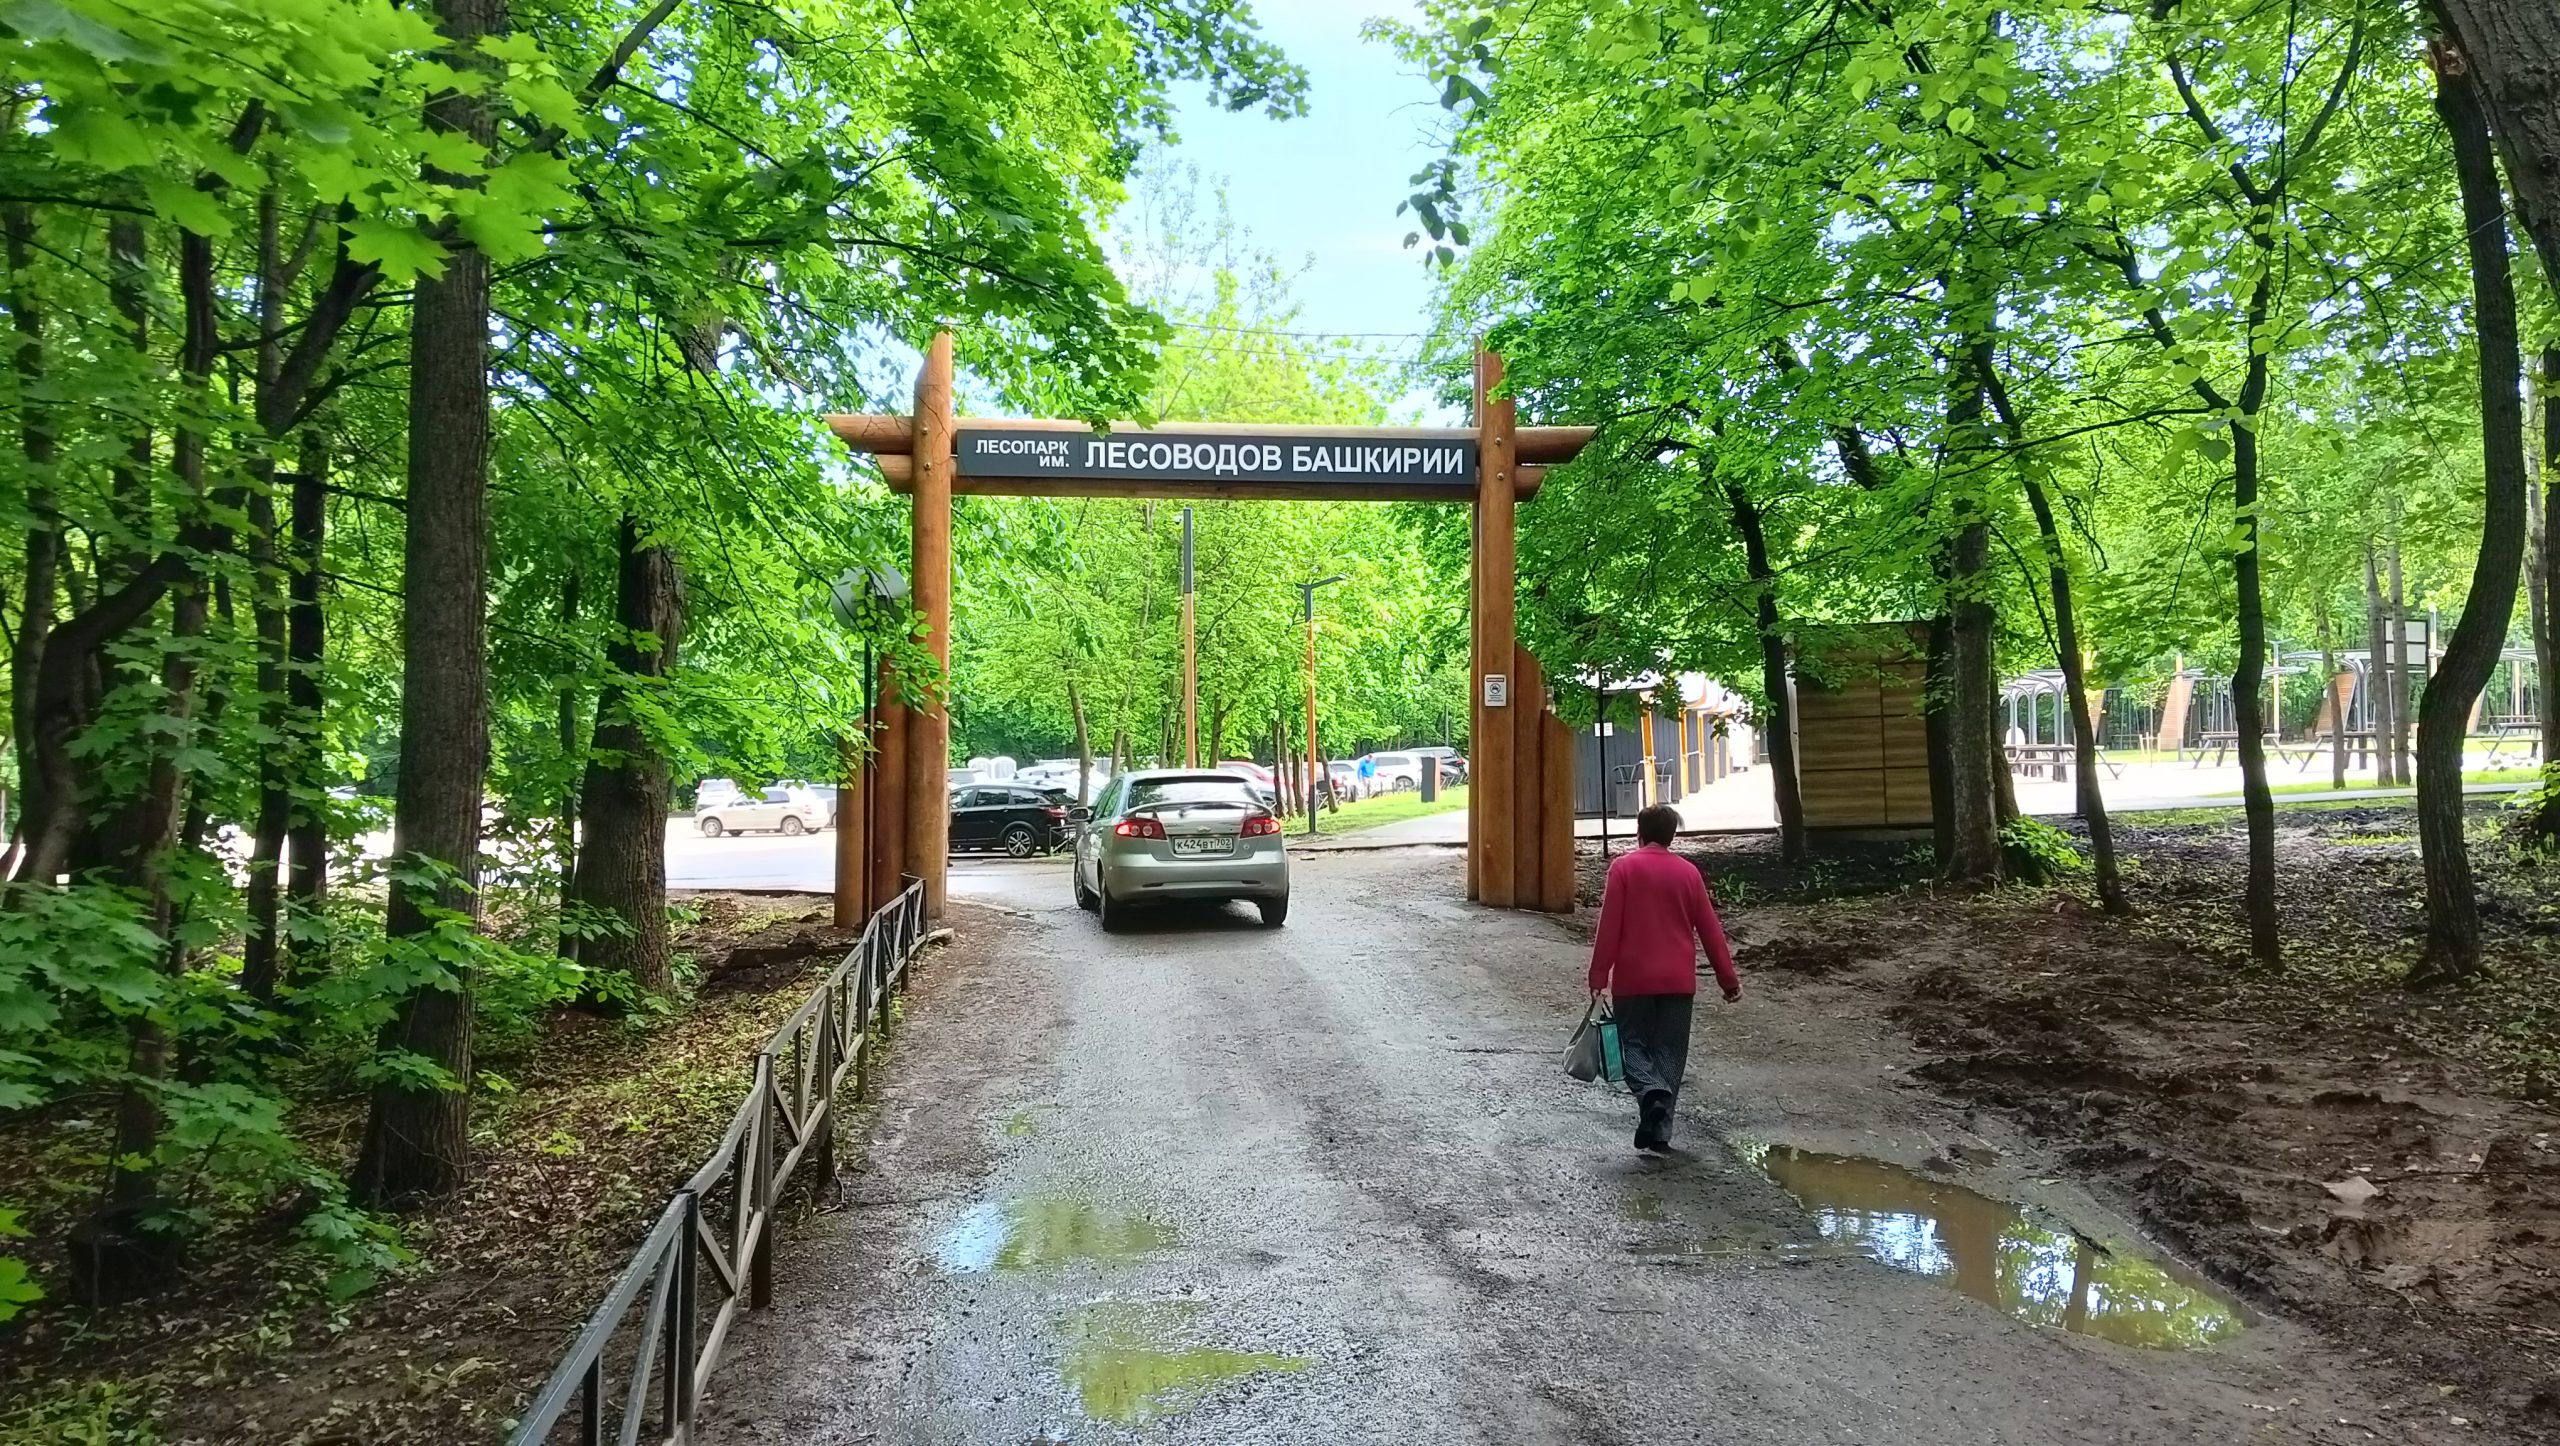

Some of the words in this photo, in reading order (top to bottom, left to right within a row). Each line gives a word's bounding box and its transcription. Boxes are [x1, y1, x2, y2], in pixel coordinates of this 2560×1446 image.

[975, 439, 1069, 455] ЛЕСОПАРК
[1039, 455, 1070, 468] ИМ.
[1084, 441, 1283, 476] ЛЕСОВОДОВ
[1292, 445, 1463, 474] БАШКИРИИ
